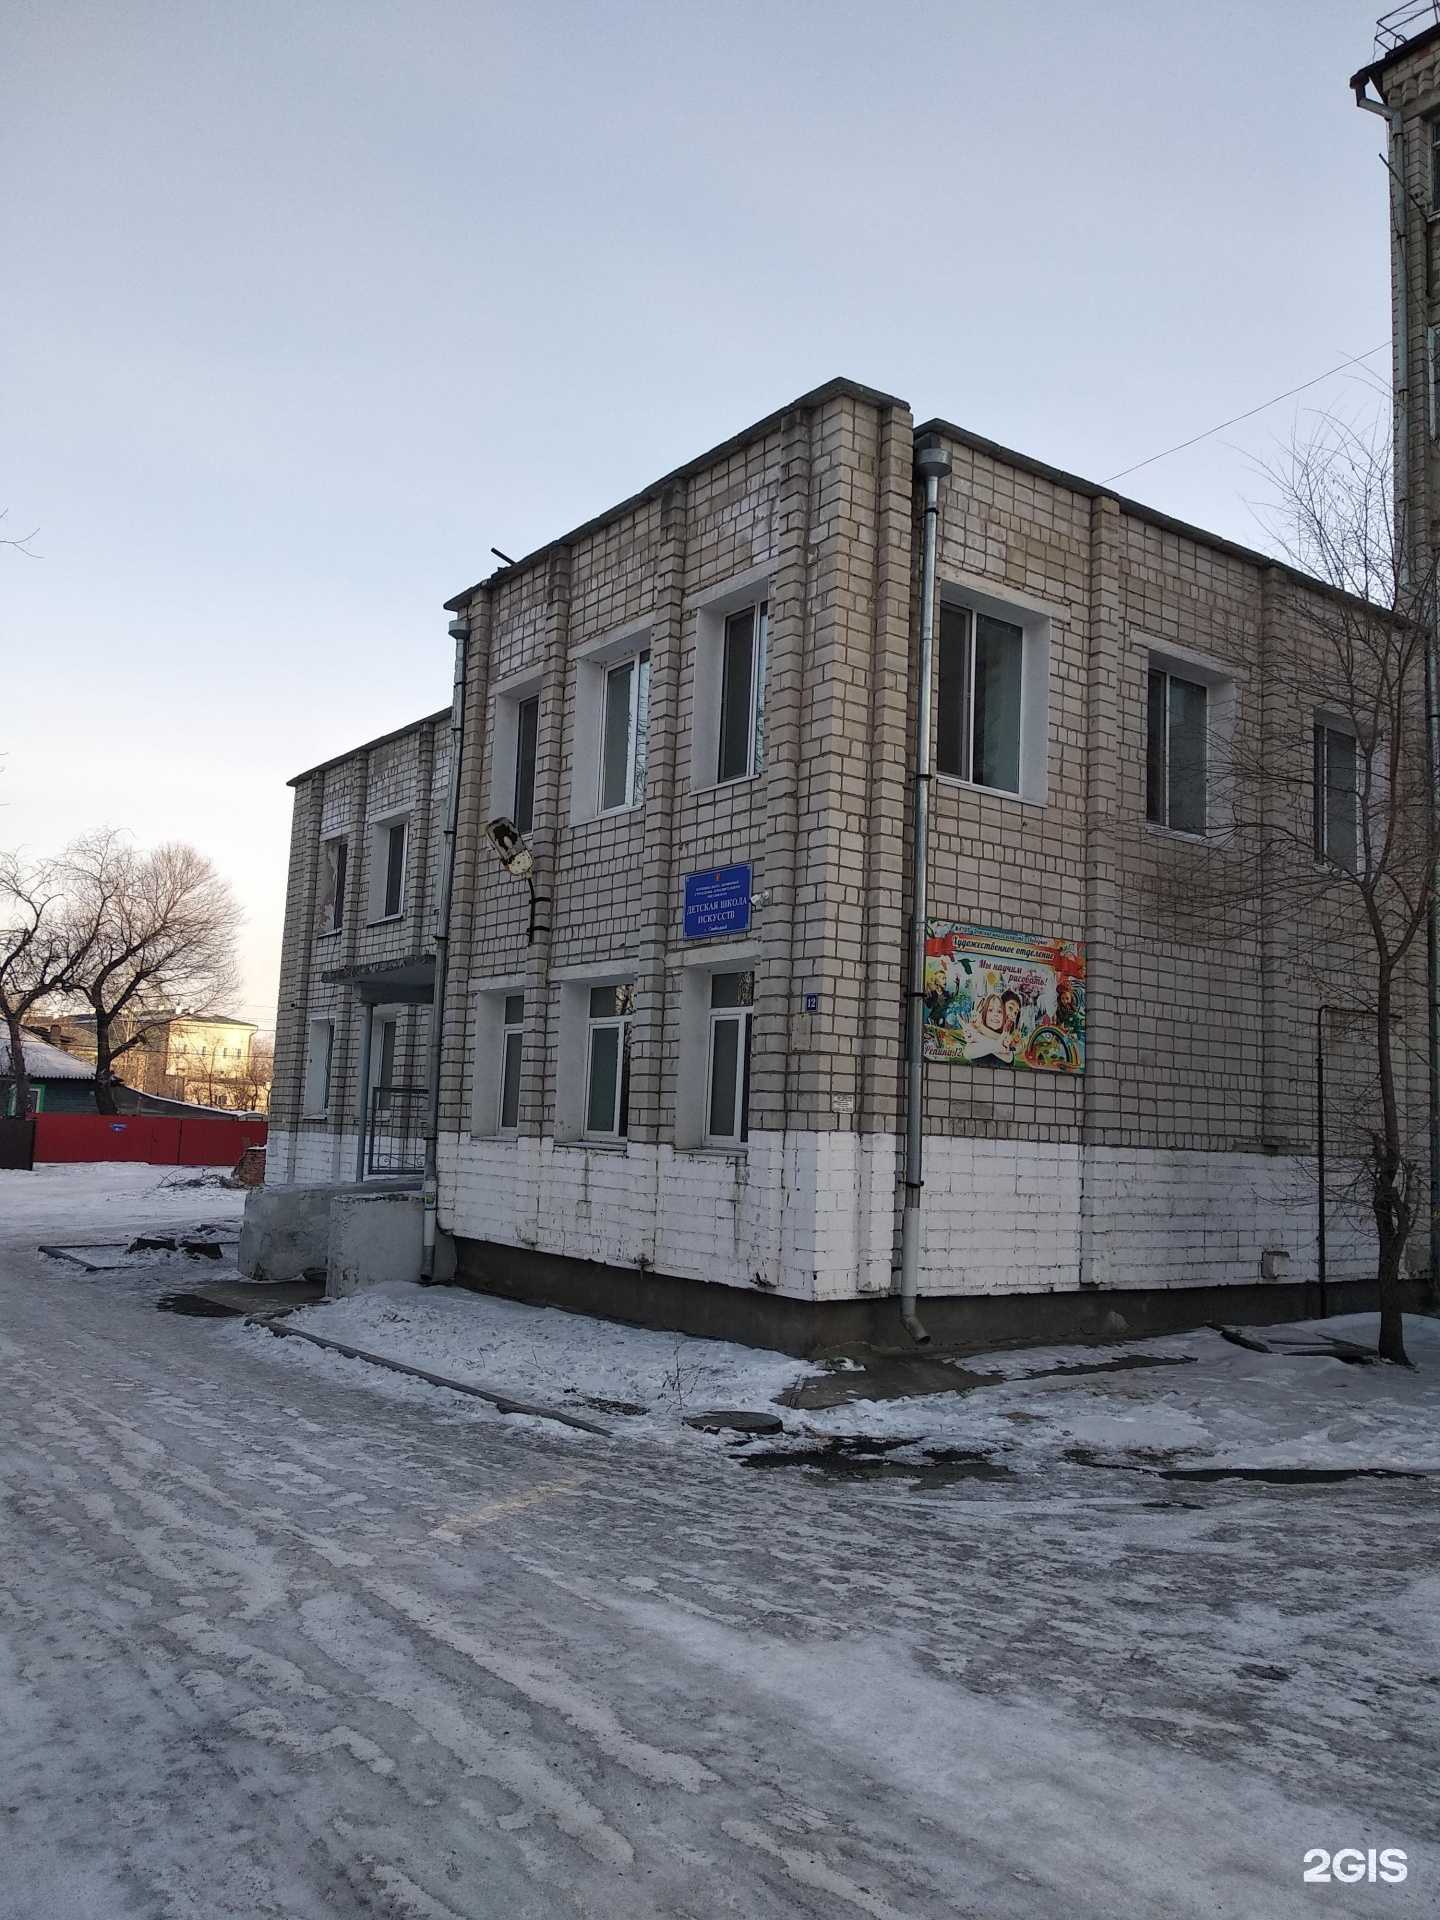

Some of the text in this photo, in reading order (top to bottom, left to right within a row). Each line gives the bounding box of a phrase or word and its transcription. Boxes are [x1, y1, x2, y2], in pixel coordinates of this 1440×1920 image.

[687, 896, 747, 915] ДЕТСКАЯ ШКОЛА
[698, 910, 735, 924] ИСКУССТВ
[953, 935, 1015, 954] Художественное
[1016, 947, 1054, 960] отделение
[979, 959, 1022, 974] Мы научим
[1008, 973, 1048, 986] рисовать!
[807, 998, 816, 1008] 12
